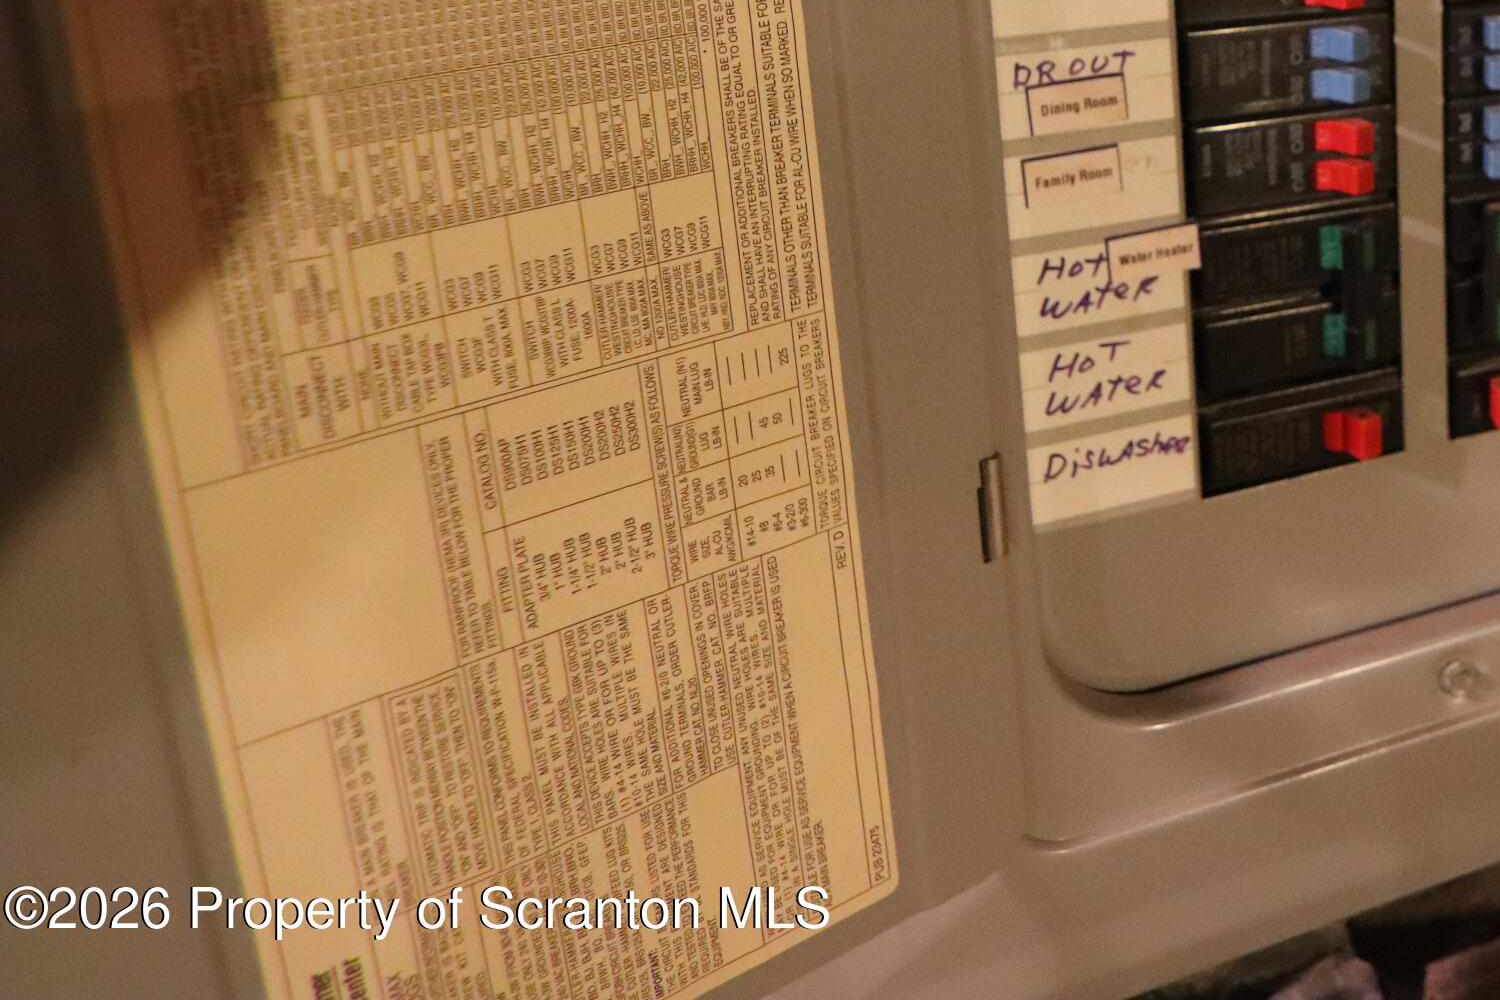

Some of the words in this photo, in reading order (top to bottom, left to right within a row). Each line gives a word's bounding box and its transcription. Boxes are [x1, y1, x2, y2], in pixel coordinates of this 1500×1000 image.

[697, 3, 711, 43] 100,000
[714, 14, 726, 37] THE
[728, 25, 738, 42] OR
[717, 38, 728, 55] OF
[730, 44, 740, 60] TO
[758, 19, 774, 70] SUITABLE
[719, 55, 730, 71] BE
[732, 61, 744, 98] EQUAL
[781, 66, 793, 82] SO
[721, 72, 734, 107] SHALL
[764, 72, 781, 133] TERMINALS
[783, 84, 797, 115] WHEN
[1040, 100, 1080, 117] Dining
[1083, 94, 1119, 110] Room
[736, 99, 749, 139] RATING
[787, 118, 800, 145] WIRE
[725, 108, 741, 167] BREAKERS
[753, 147, 767, 197] BREAKER
[771, 134, 787, 184] BREAKER
[790, 146, 803, 177] AL-CU
[741, 141, 758, 219] INTERRUPTING
[793, 179, 806, 200] FOR
[1034, 172, 1076, 190] Family
[1079, 166, 1113, 182] Room
[732, 167, 748, 230] ADDITIONAL
[777, 186, 790, 214] THAN
[750, 220, 760, 236] AN
[759, 198, 772, 241] CIRCUIT
[781, 216, 794, 253] OTHER
[796, 202, 811, 249] SUITABLE
[740, 231, 750, 248] OR
[752, 237, 763, 265] HAVE
[764, 242, 775, 264] ANY
[742, 249, 759, 326] REPLACEMENT
[755, 265, 767, 299] SHALL
[766, 265, 777, 280] OF
[785, 253, 801, 312] TERMINALS
[801, 251, 817, 308] TERMINALS
[759, 300, 770, 323] AND
[768, 281, 781, 320] RATING
[797, 318, 808, 339] THE
[800, 342, 810, 358] TO
[802, 361, 814, 390] LUGS
[816, 373, 830, 412] CIRCUIT
[650, 410, 661, 424] AS
[806, 393, 820, 441] BREAKER
[821, 415, 832, 431] ON
[473, 428, 488, 452] NO.
[652, 423, 668, 470] SCREW(S)
[811, 444, 825, 486] CIRCUIT
[823, 434, 838, 485] SPECIFIED
[477, 452, 498, 511] CATALOG
[658, 467, 674, 520] PRESSURE
[817, 488, 830, 528] TORQUE
[829, 487, 842, 524] VALUES
[665, 520, 678, 544] WIRE
[833, 529, 845, 539] D
[668, 543, 683, 583] TORQUE
[834, 541, 848, 568] REV.
[495, 565, 514, 613] FITTING
[873, 857, 885, 880] PUB
